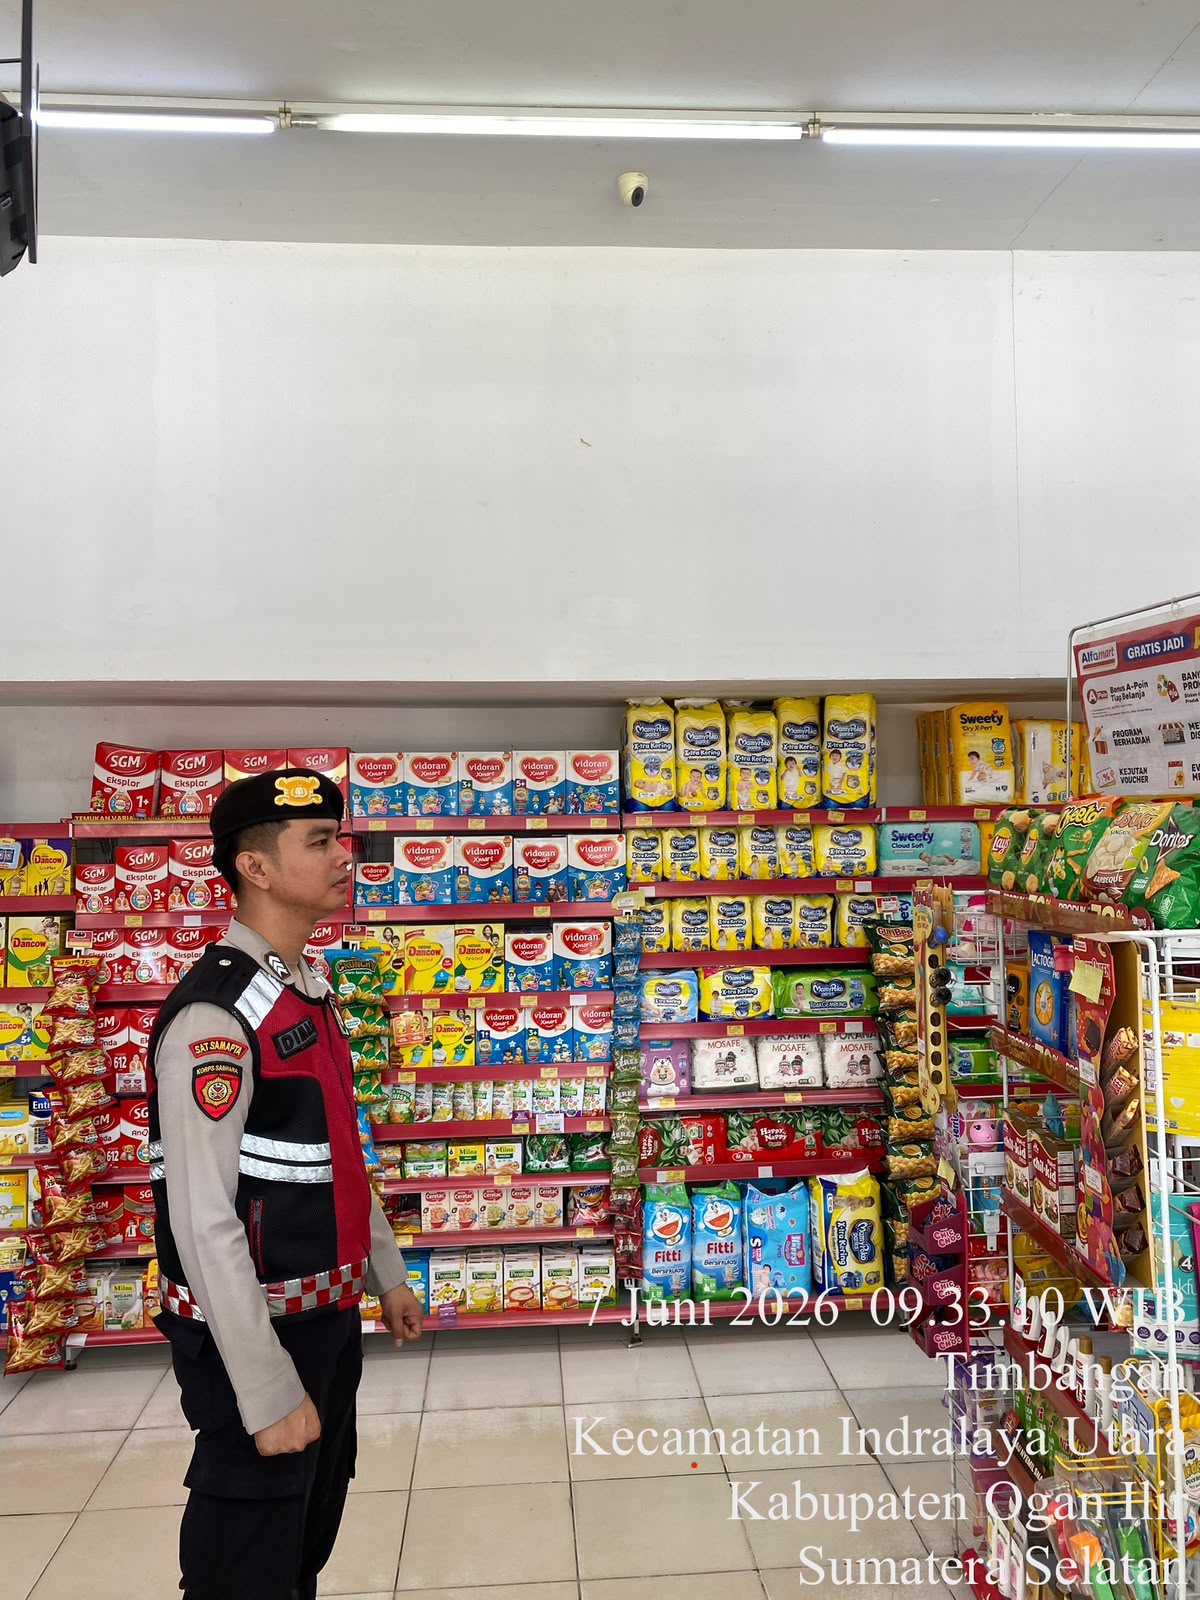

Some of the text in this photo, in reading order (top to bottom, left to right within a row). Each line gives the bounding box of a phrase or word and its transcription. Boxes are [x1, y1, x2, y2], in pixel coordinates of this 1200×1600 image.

[1127, 636, 1185, 660] GRATIS JADI
[1082, 647, 1115, 664] Alfamart
[1110, 680, 1149, 694] Bonus A-Poin
[1122, 690, 1146, 701] Belanja
[960, 714, 1003, 726] Sweety
[1112, 727, 1143, 739] PROGRAM
[1114, 735, 1151, 747] BERHADIAH
[651, 743, 672, 751] Kering
[110, 756, 141, 768] SGM
[177, 756, 206, 770] SGM
[244, 756, 268, 768] SGM
[305, 754, 329, 766] SGM
[576, 760, 608, 768] vidoran
[360, 762, 393, 770] vidoran
[414, 762, 447, 770] vidoran
[1119, 767, 1148, 776] KEJUTAN
[107, 777, 140, 787] Eksplor
[175, 780, 208, 788] Eksplor
[1120, 774, 1149, 784] VOUCHER
[136, 796, 149, 807] 1+
[1056, 801, 1101, 837] Cheeto
[891, 830, 934, 844] Sweety
[1152, 829, 1193, 849] Doritos
[185, 845, 214, 859] SGM
[407, 847, 441, 855] vidoran
[525, 849, 556, 857] vidoran
[580, 844, 614, 852] vidoran
[34, 855, 63, 864] Dancow
[128, 852, 155, 866] SGM
[84, 869, 105, 880] SGM
[127, 874, 157, 882] Eksplor
[183, 869, 216, 877] Eksplor
[154, 890, 166, 900] 3+
[214, 884, 227, 897] 3+
[135, 930, 154, 942] SGM
[176, 931, 199, 943] SGM
[13, 938, 46, 948] Dancow
[409, 947, 441, 956] Dancow
[459, 946, 491, 955] Dancow
[436, 1025, 464, 1033] Dancow
[195, 1041, 243, 1056] SAT SAMAPTA
[708, 1040, 741, 1049] MOSAFE
[772, 1044, 806, 1052] MOSAFE
[840, 1043, 873, 1051] MOSAFE
[197, 1064, 239, 1074] KORPS SABHARA
[933, 1229, 956, 1241] CHIC
[938, 1233, 962, 1248] CHOC
[707, 1242, 734, 1254] Fitti
[838, 1239, 849, 1266] Kering
[655, 1250, 682, 1263] Fitti
[1181, 1256, 1193, 1270] 4
[933, 1281, 955, 1292] CHIC
